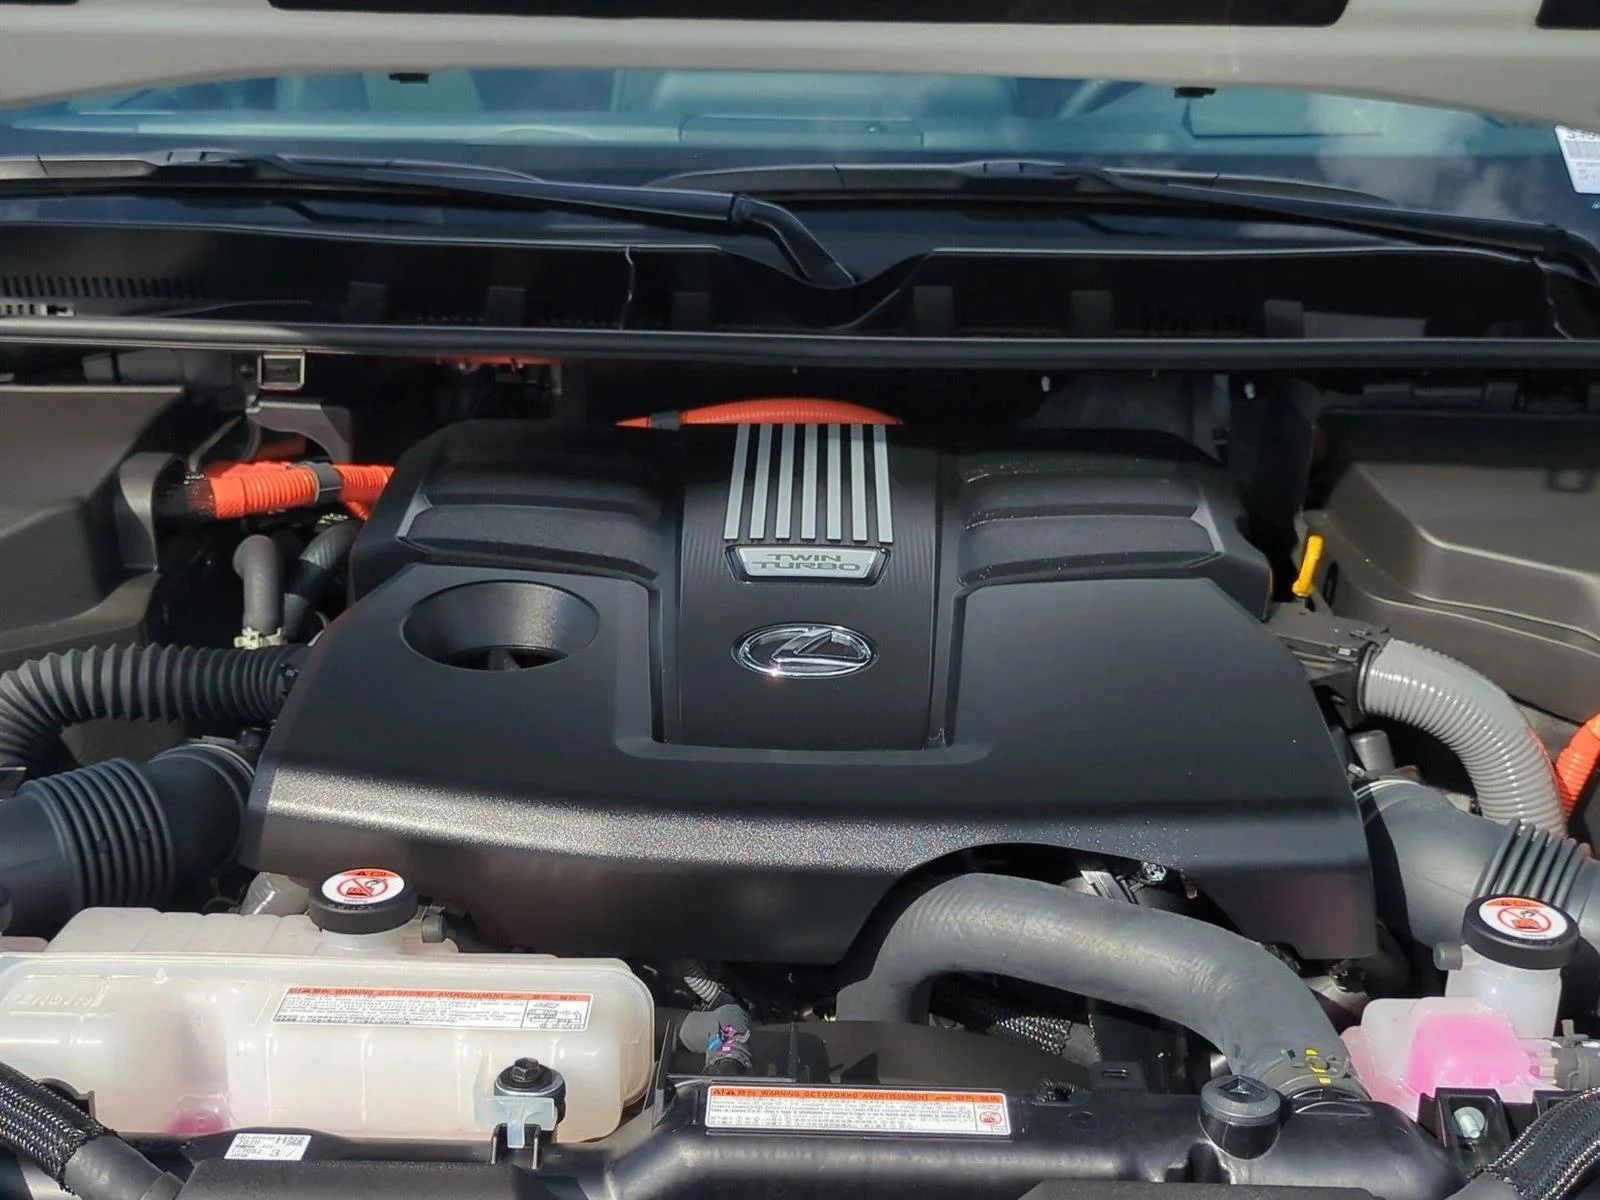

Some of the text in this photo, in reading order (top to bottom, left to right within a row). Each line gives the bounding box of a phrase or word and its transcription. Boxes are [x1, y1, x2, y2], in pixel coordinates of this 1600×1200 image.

[767, 553, 842, 562] TWIN
[752, 561, 861, 571] TURBO
[862, 1093, 928, 1101] AVERTISSEMENT
